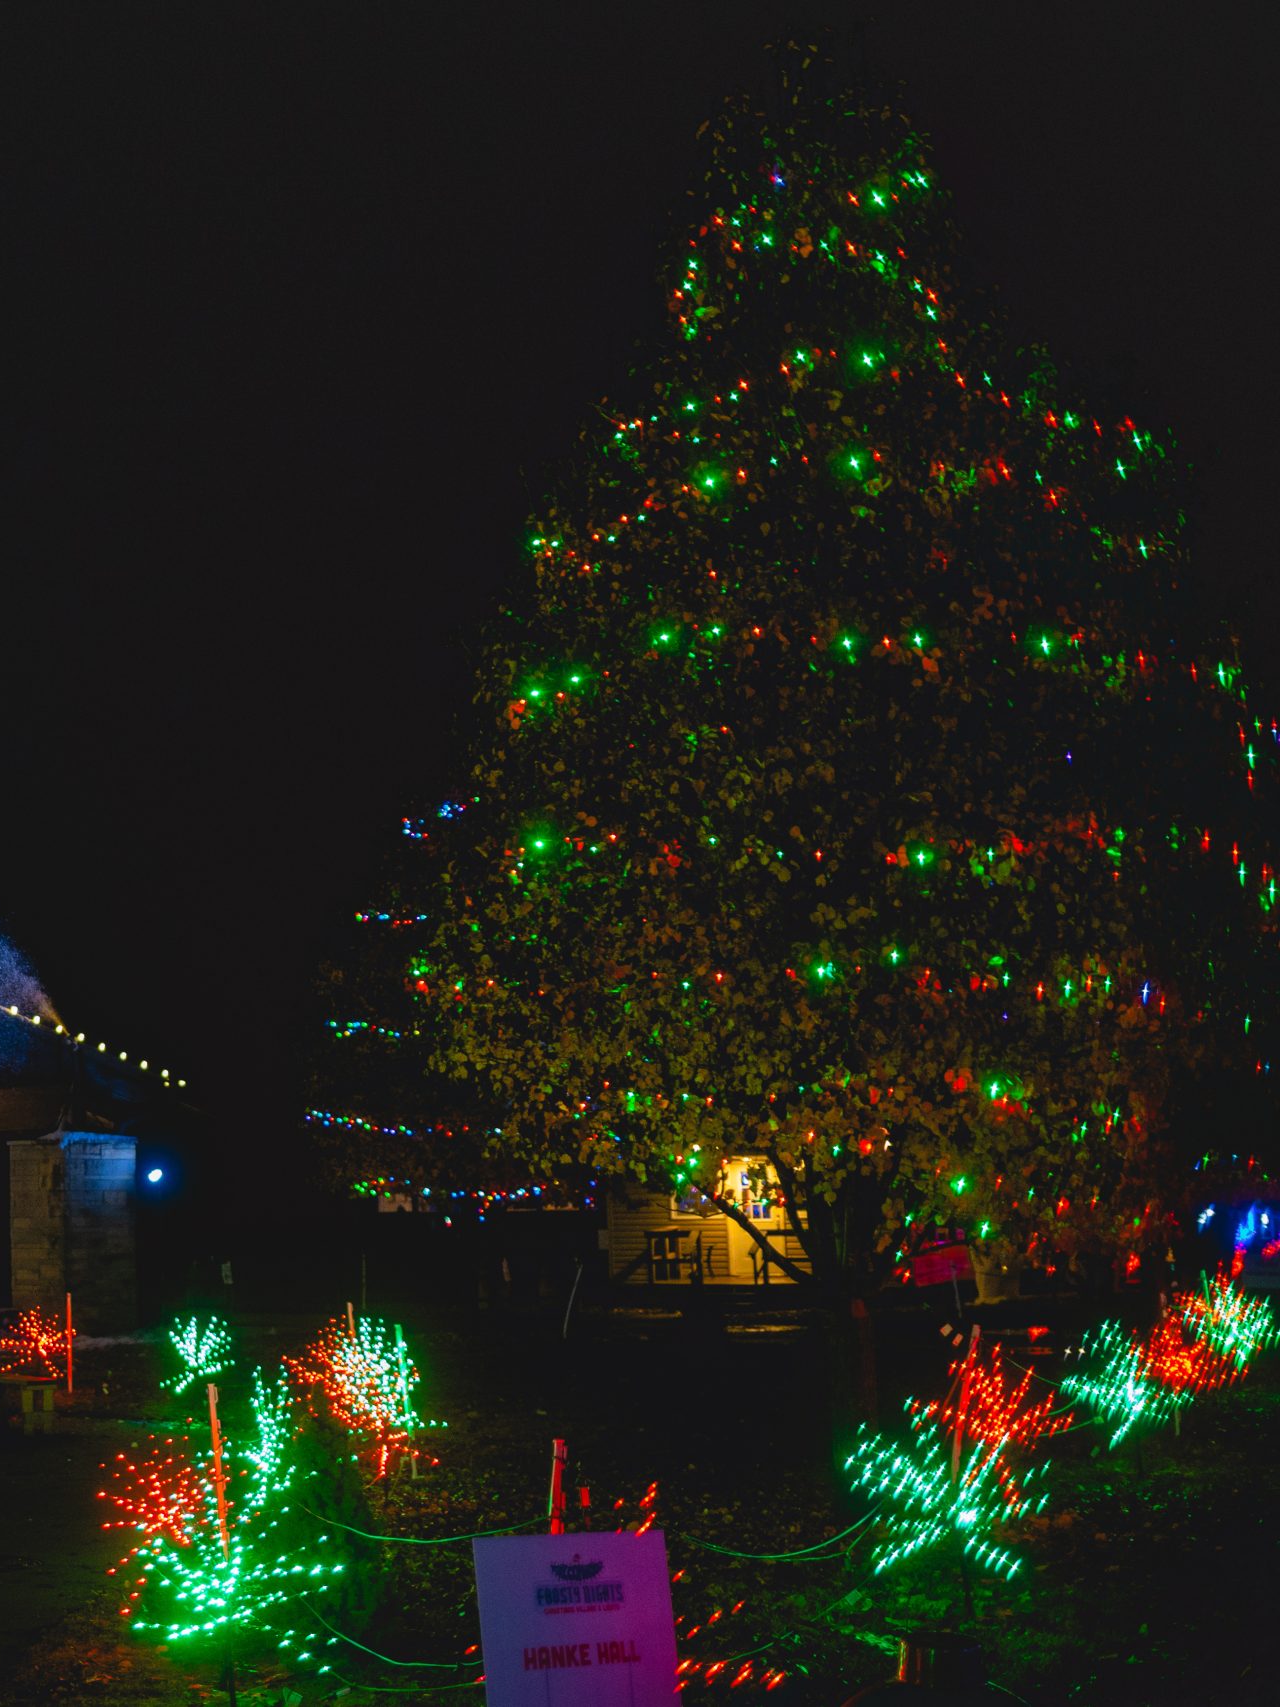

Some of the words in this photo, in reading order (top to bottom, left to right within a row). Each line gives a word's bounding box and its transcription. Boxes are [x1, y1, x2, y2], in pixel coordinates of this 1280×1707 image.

[537, 1586, 580, 1606] FROSTY
[524, 1644, 592, 1671] HANKE
[597, 1640, 642, 1665] HALL
